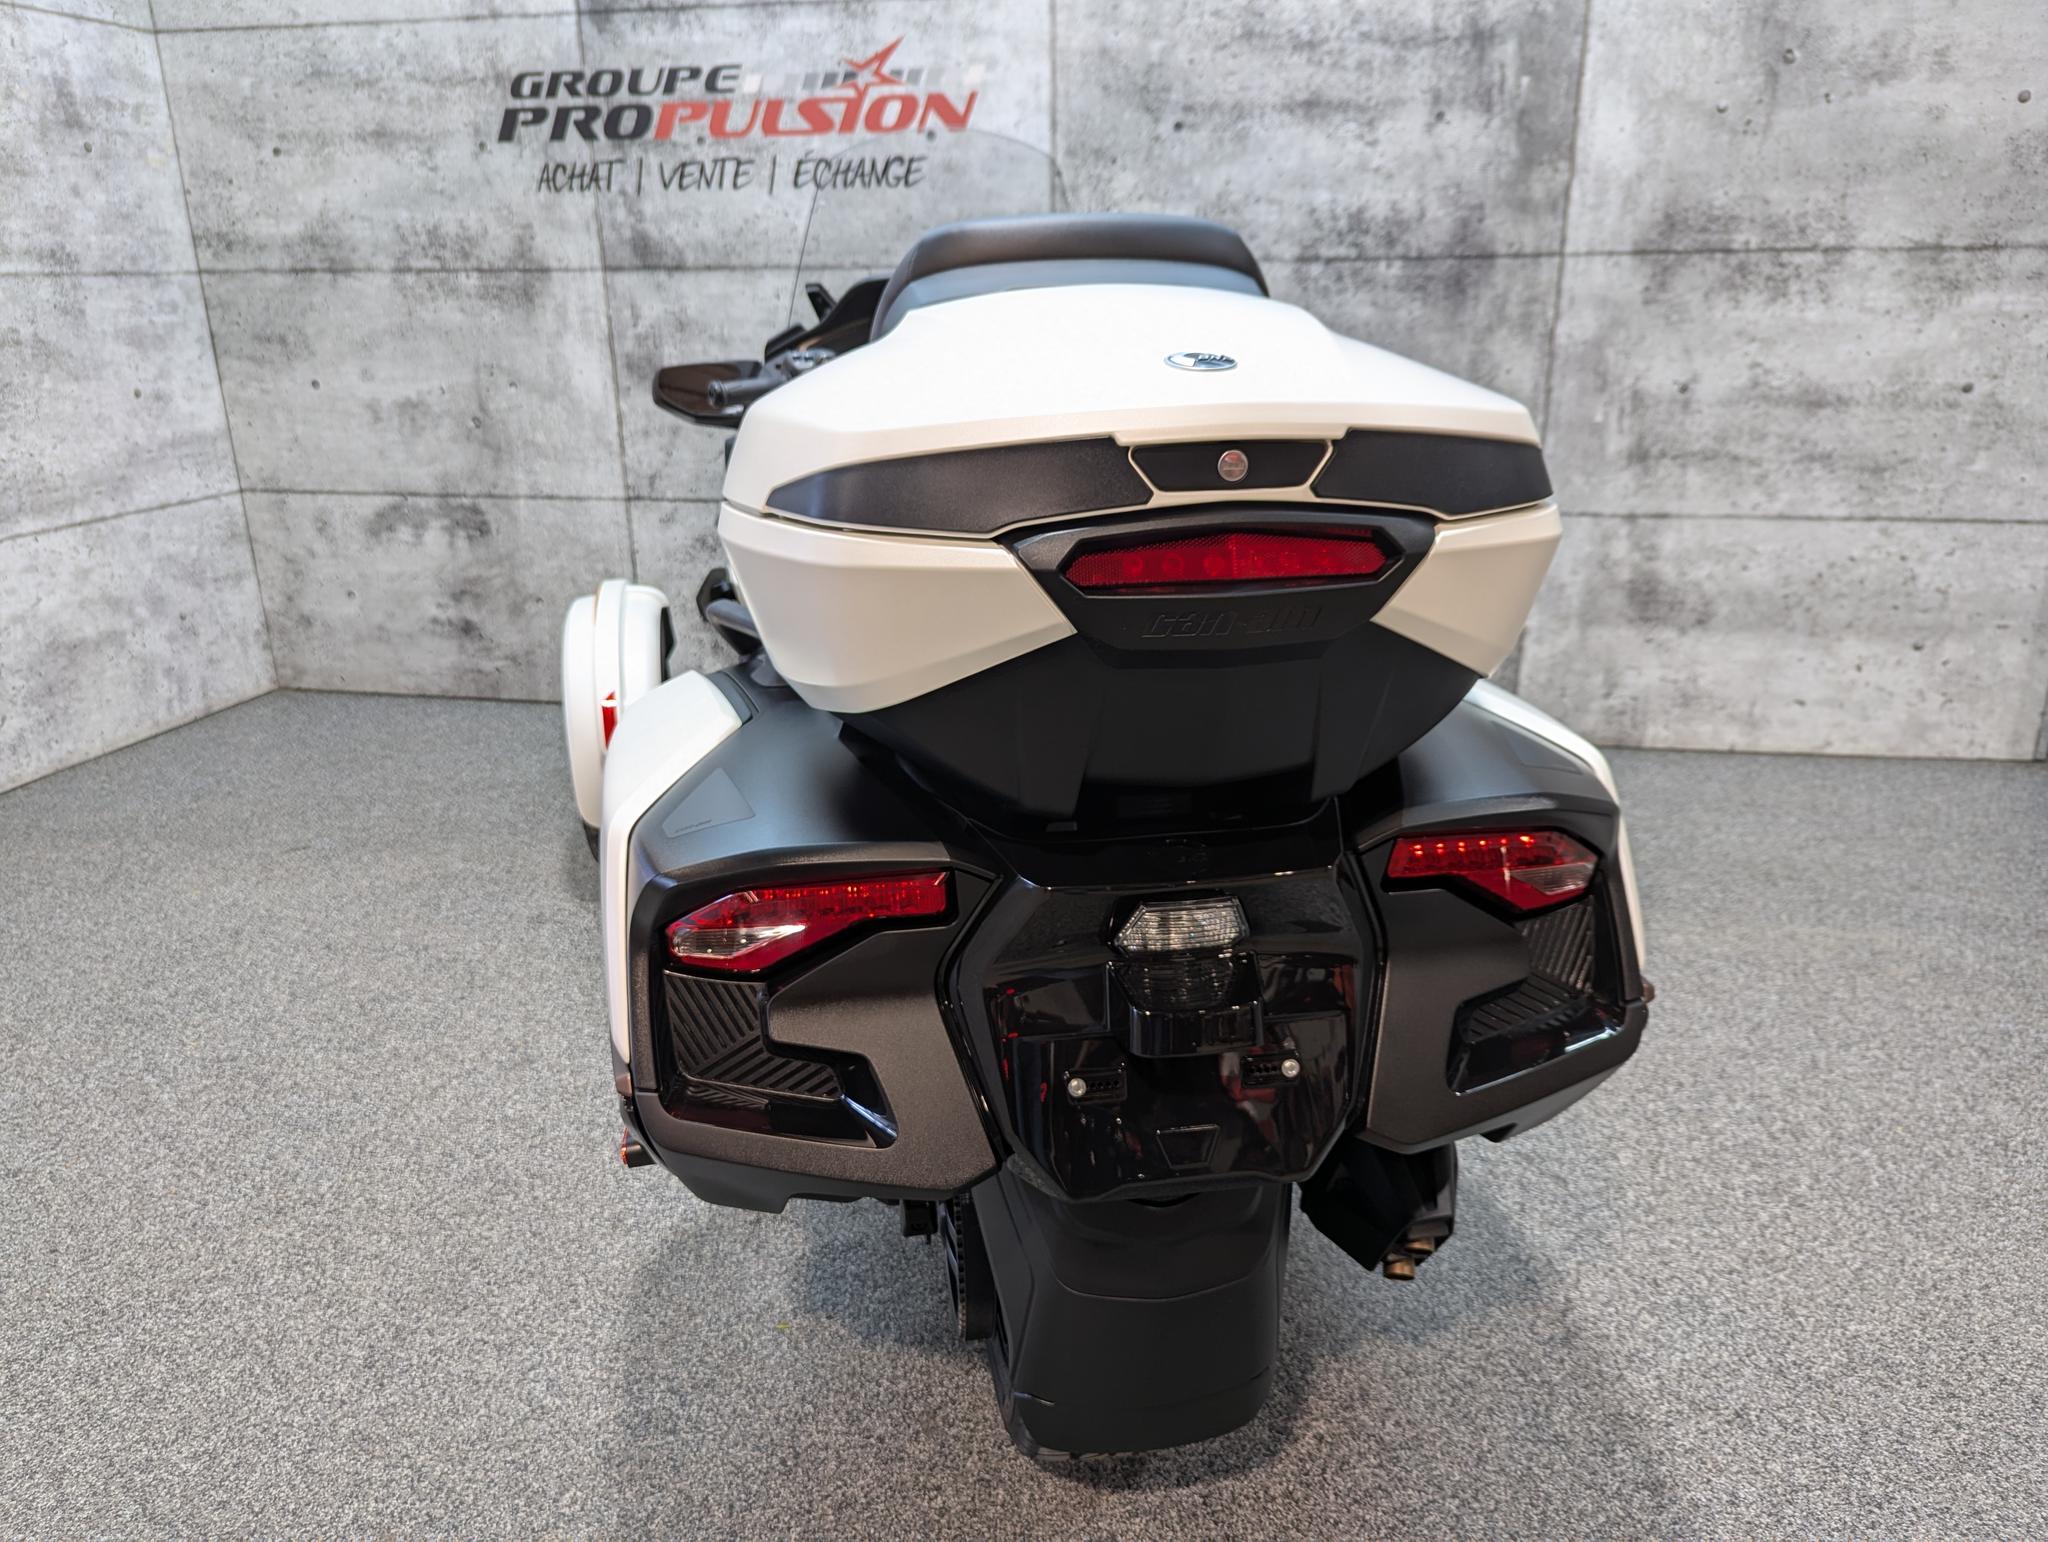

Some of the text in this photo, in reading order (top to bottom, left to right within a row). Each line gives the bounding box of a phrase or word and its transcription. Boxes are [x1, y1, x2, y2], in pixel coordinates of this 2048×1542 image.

[510, 65, 742, 99] GROUPE
[498, 90, 978, 142] PROPULSION
[538, 159, 625, 193] ACHAT
[659, 157, 755, 192] VENTE
[793, 151, 928, 190] ÉCHANGE
